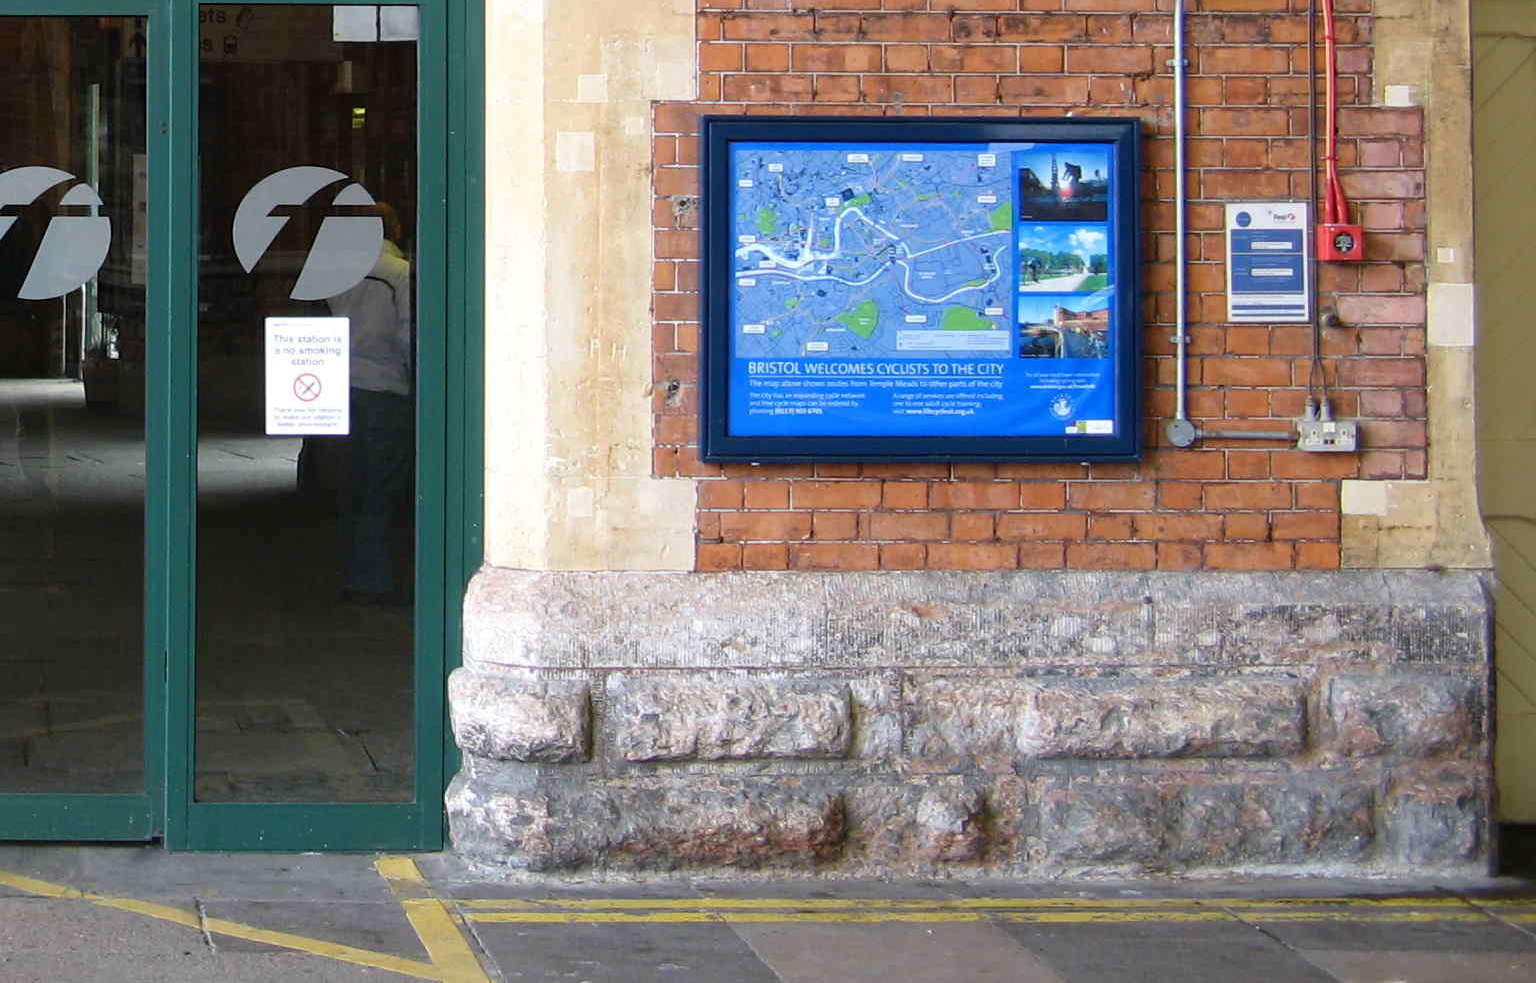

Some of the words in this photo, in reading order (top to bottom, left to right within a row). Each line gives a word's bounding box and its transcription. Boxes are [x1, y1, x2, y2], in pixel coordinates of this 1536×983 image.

[273, 334, 294, 344] This
[298, 335, 331, 344] station
[334, 335, 342, 344] is
[283, 347, 296, 355] no
[298, 346, 342, 357] smoking
[291, 357, 325, 366] station
[748, 361, 802, 375] BRISTOL
[804, 362, 874, 375] WELCOMES
[876, 363, 930, 376] CYCLISTS
[932, 363, 949, 376] TO
[951, 363, 975, 376] THE
[976, 363, 1005, 376] CITY
